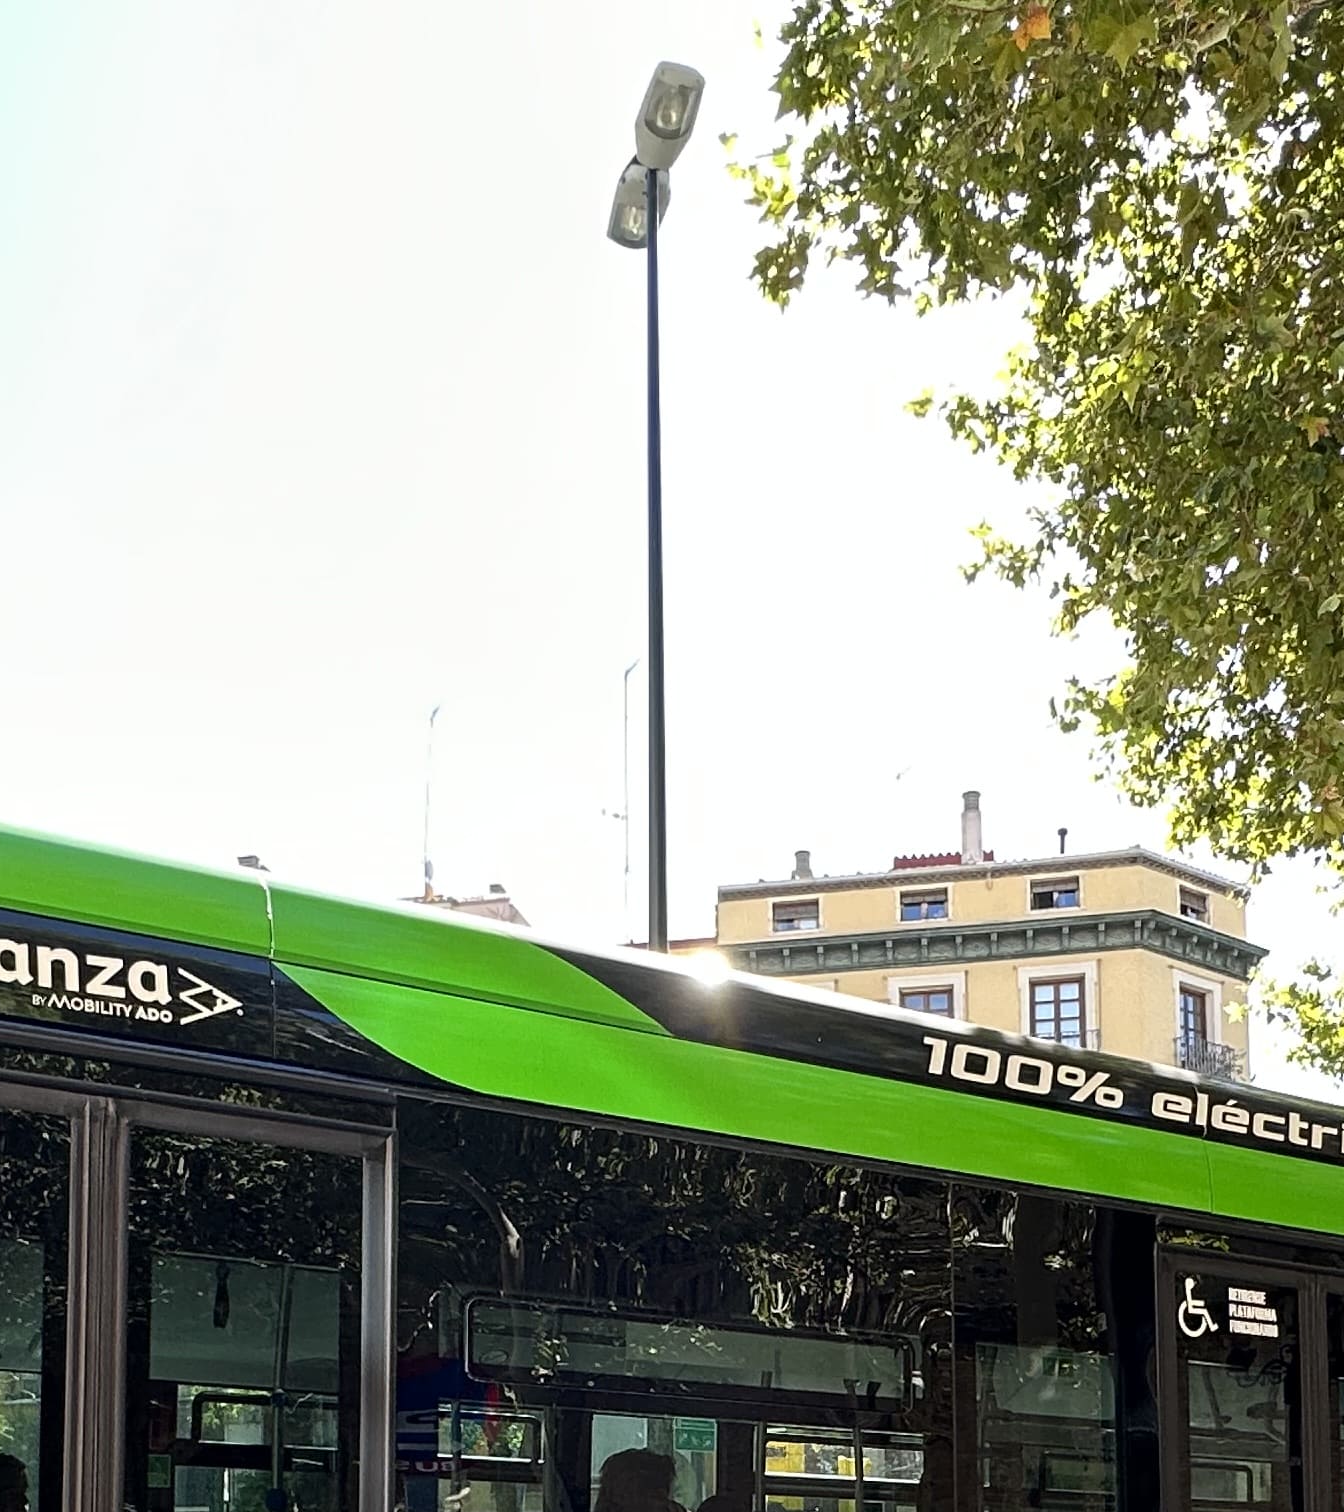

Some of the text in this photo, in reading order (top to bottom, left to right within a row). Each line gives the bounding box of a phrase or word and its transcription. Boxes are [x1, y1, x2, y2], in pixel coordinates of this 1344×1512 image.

[32, 993, 173, 1023] BY MOBILITY ADO
[922, 1035, 1124, 1110] 100%
